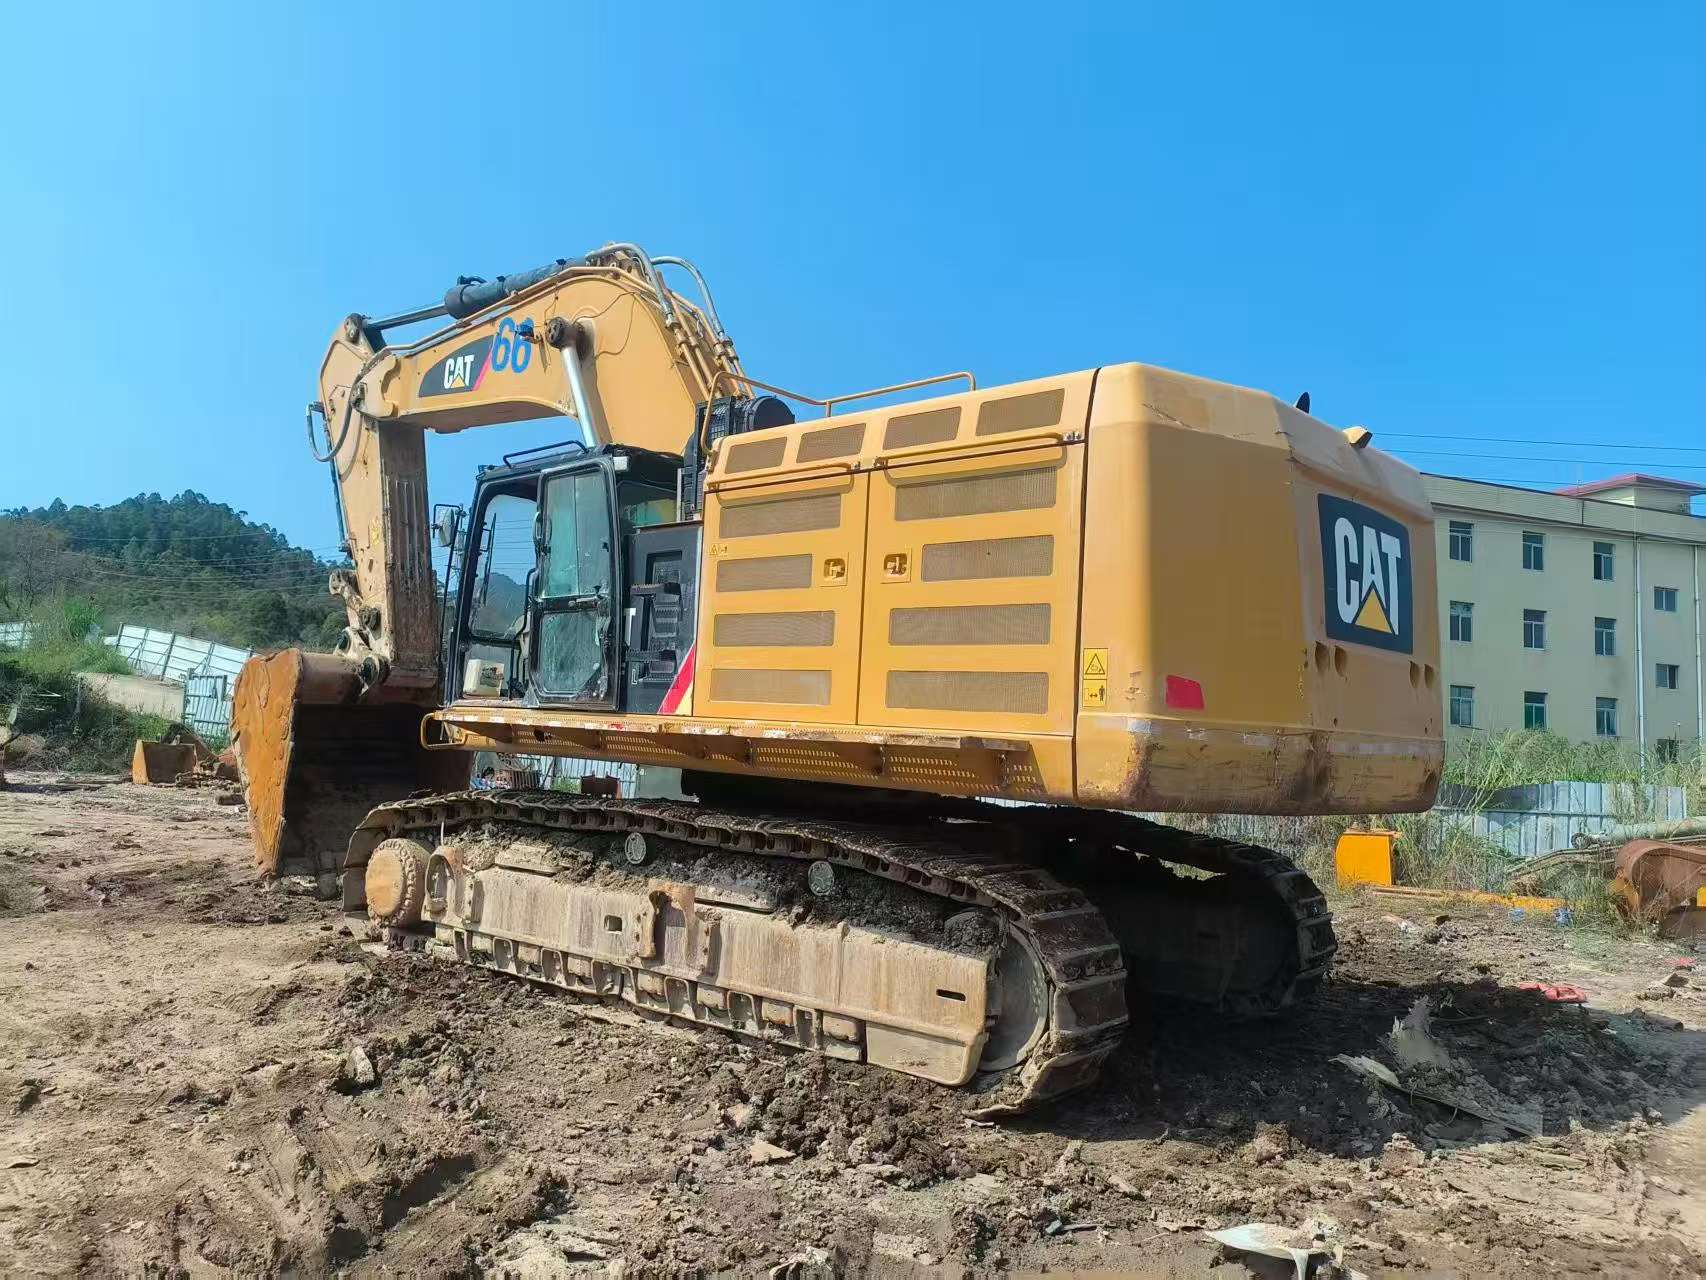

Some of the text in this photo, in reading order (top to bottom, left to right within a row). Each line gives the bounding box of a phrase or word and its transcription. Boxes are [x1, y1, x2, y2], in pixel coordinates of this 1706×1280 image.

[443, 354, 475, 389] CAT
[492, 317, 534, 373] 66
[1334, 517, 1401, 636] CAT
